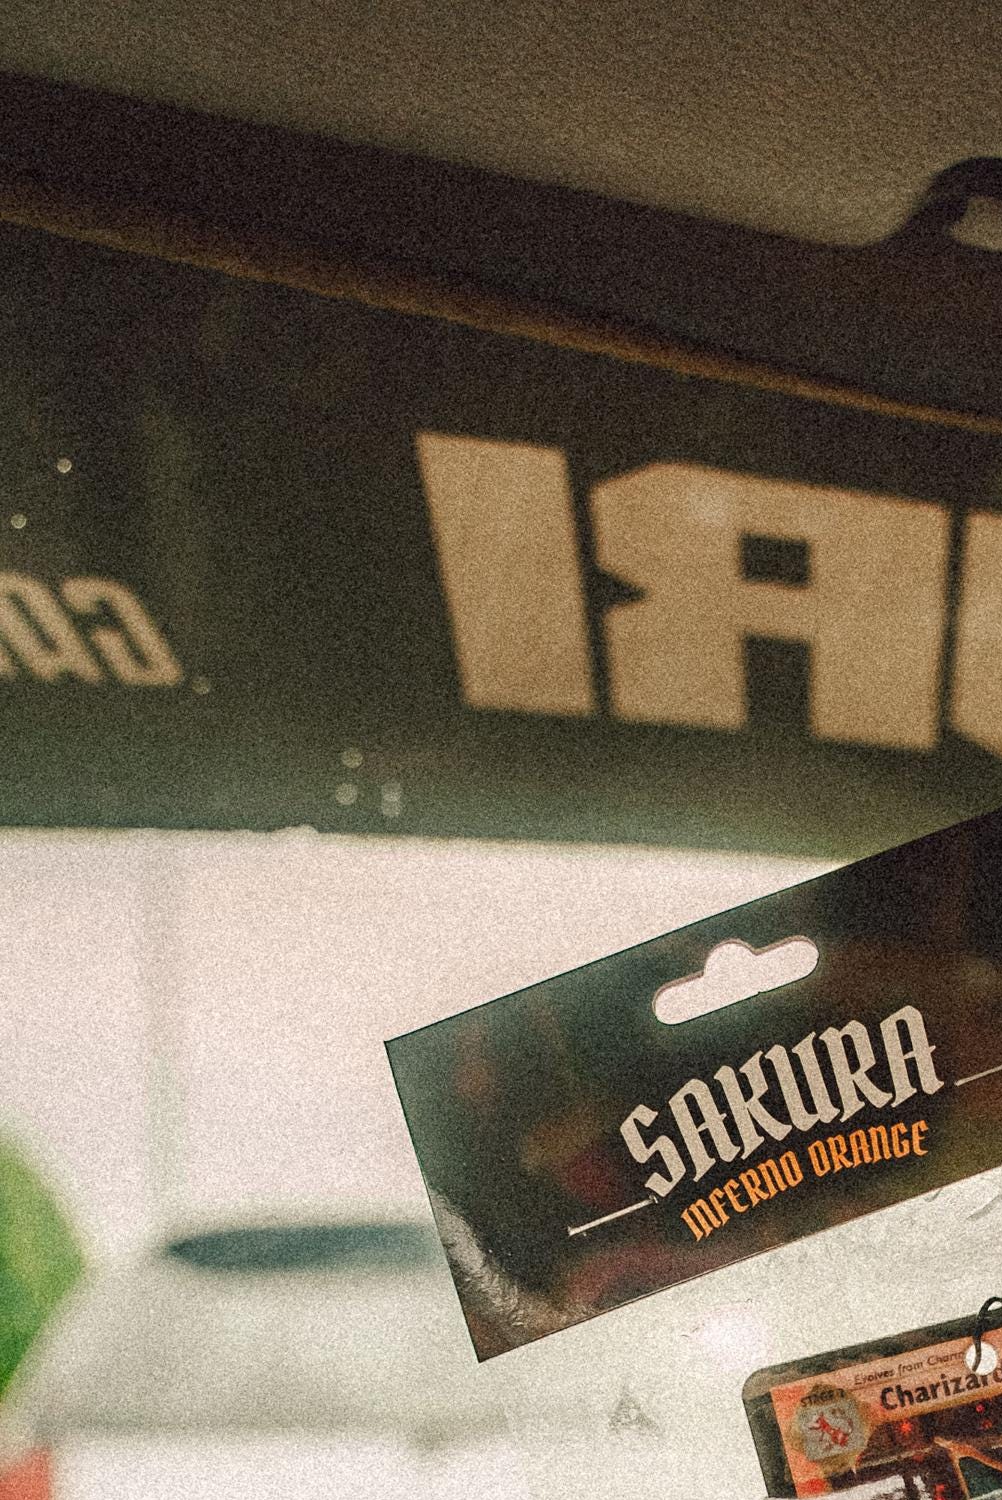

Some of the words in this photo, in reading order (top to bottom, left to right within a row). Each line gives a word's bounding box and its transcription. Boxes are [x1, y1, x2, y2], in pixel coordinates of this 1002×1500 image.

[619, 1005, 944, 1197] SAKURA
[681, 1150, 803, 1241] INFERNO
[807, 1119, 929, 1177] ORANGE
[853, 1367, 895, 1385] Evolves
[897, 1359, 924, 1375] from
